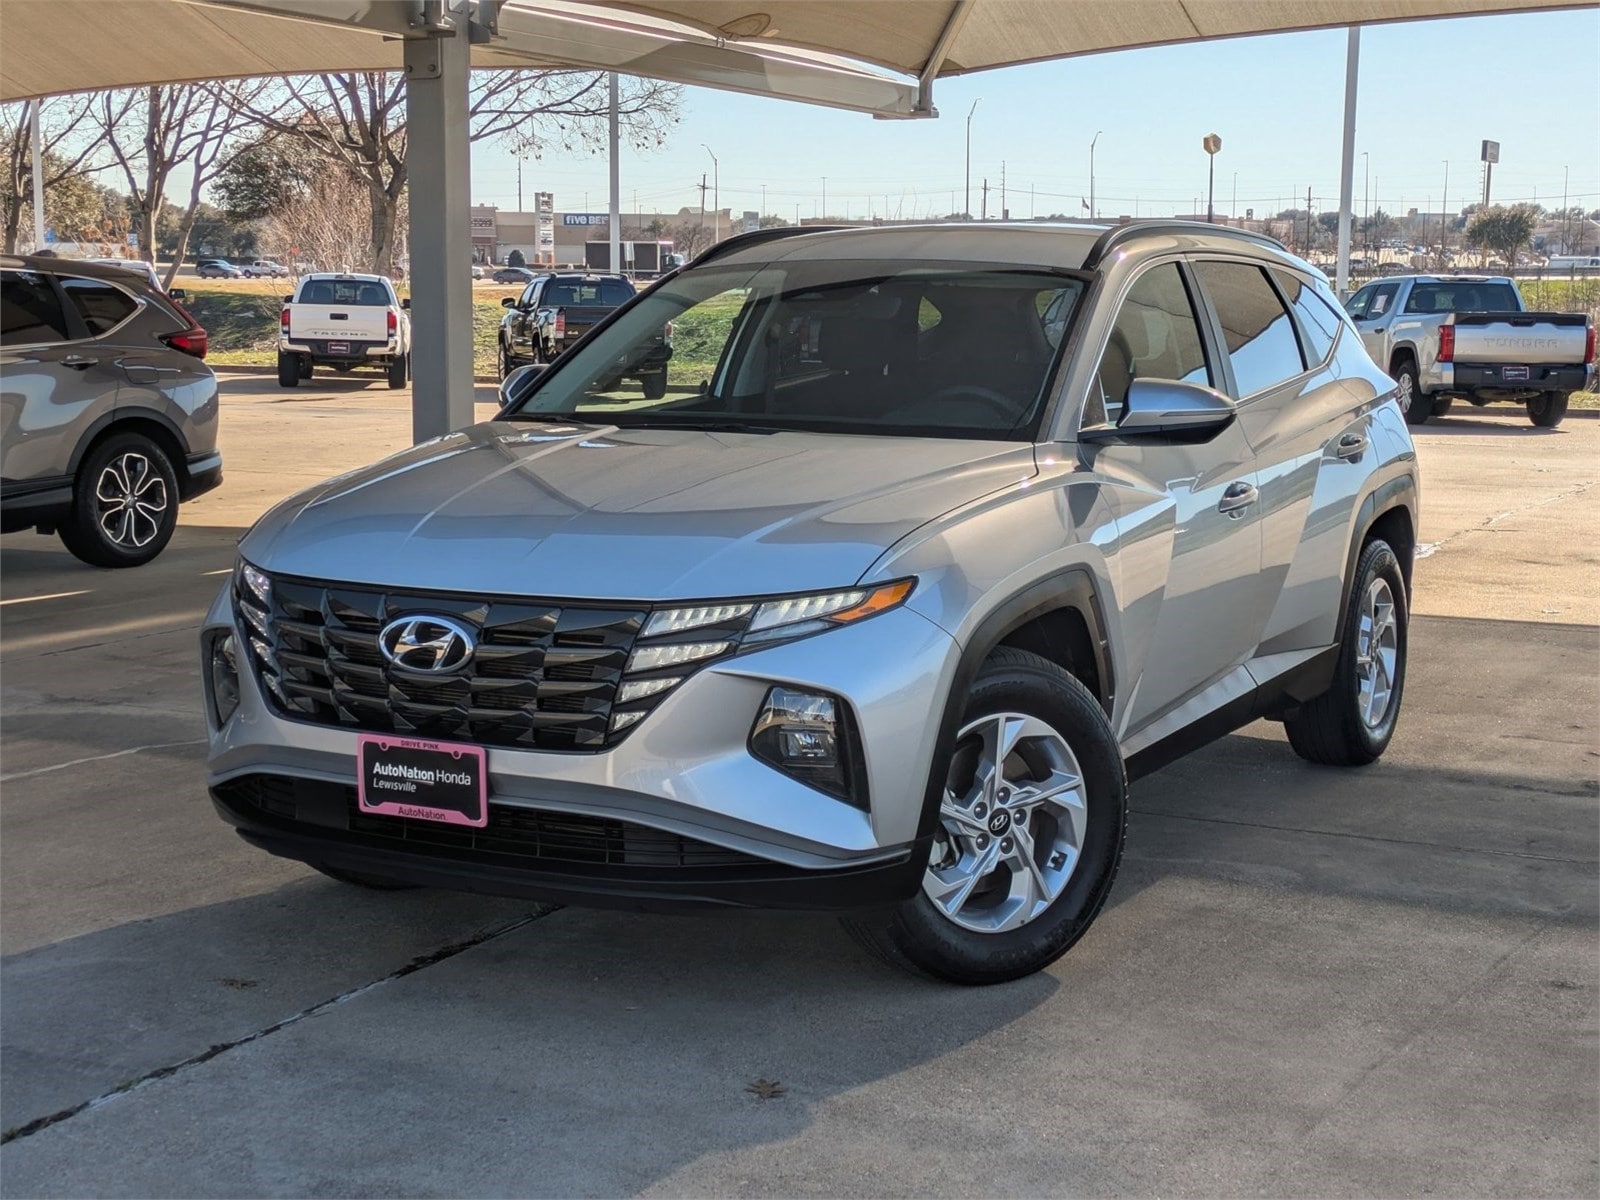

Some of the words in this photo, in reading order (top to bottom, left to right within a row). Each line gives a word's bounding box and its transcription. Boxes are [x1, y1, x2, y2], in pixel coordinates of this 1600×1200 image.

[565, 215, 587, 225] five
[1483, 337, 1559, 349] TUNDRA
[400, 740, 420, 748] DRIVE
[422, 742, 440, 750] PINK
[373, 762, 434, 781] AutoNation
[436, 769, 471, 785] Honda
[373, 778, 417, 793] Lewisville
[398, 807, 446, 820] AutoNation
